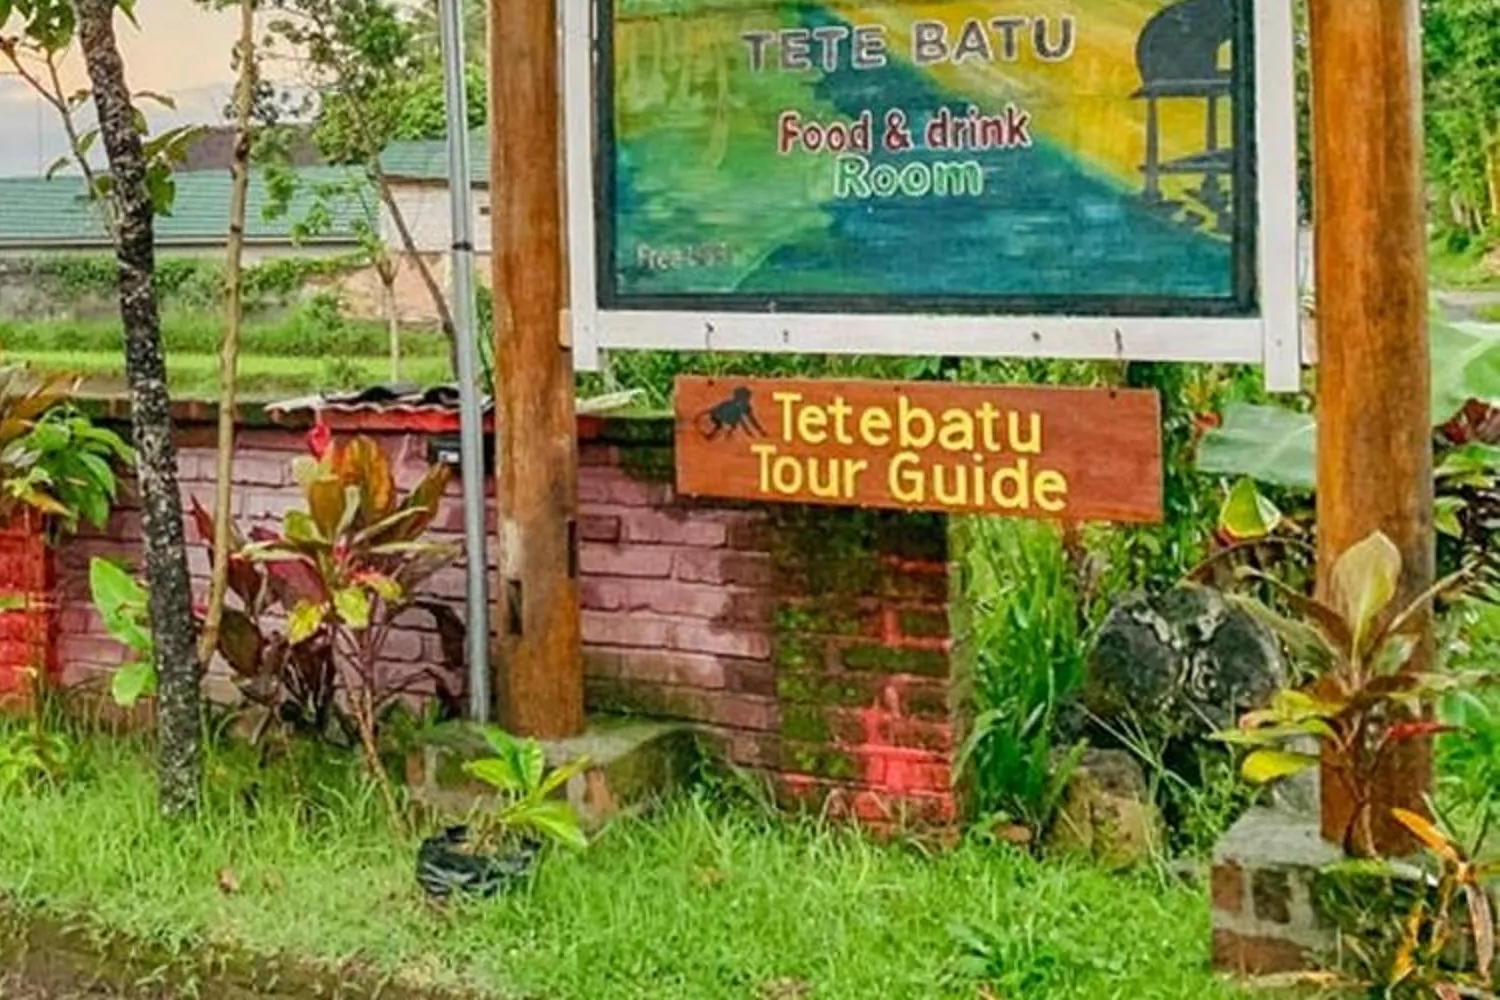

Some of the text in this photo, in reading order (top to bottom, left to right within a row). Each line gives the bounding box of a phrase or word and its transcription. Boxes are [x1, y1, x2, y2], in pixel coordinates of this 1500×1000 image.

[743, 13, 1076, 73] TETE BATU
[777, 101, 1034, 154] Food & drink
[833, 153, 985, 199] Room
[772, 391, 1043, 454] Tetebatu
[750, 443, 1069, 512] Tour Guide
